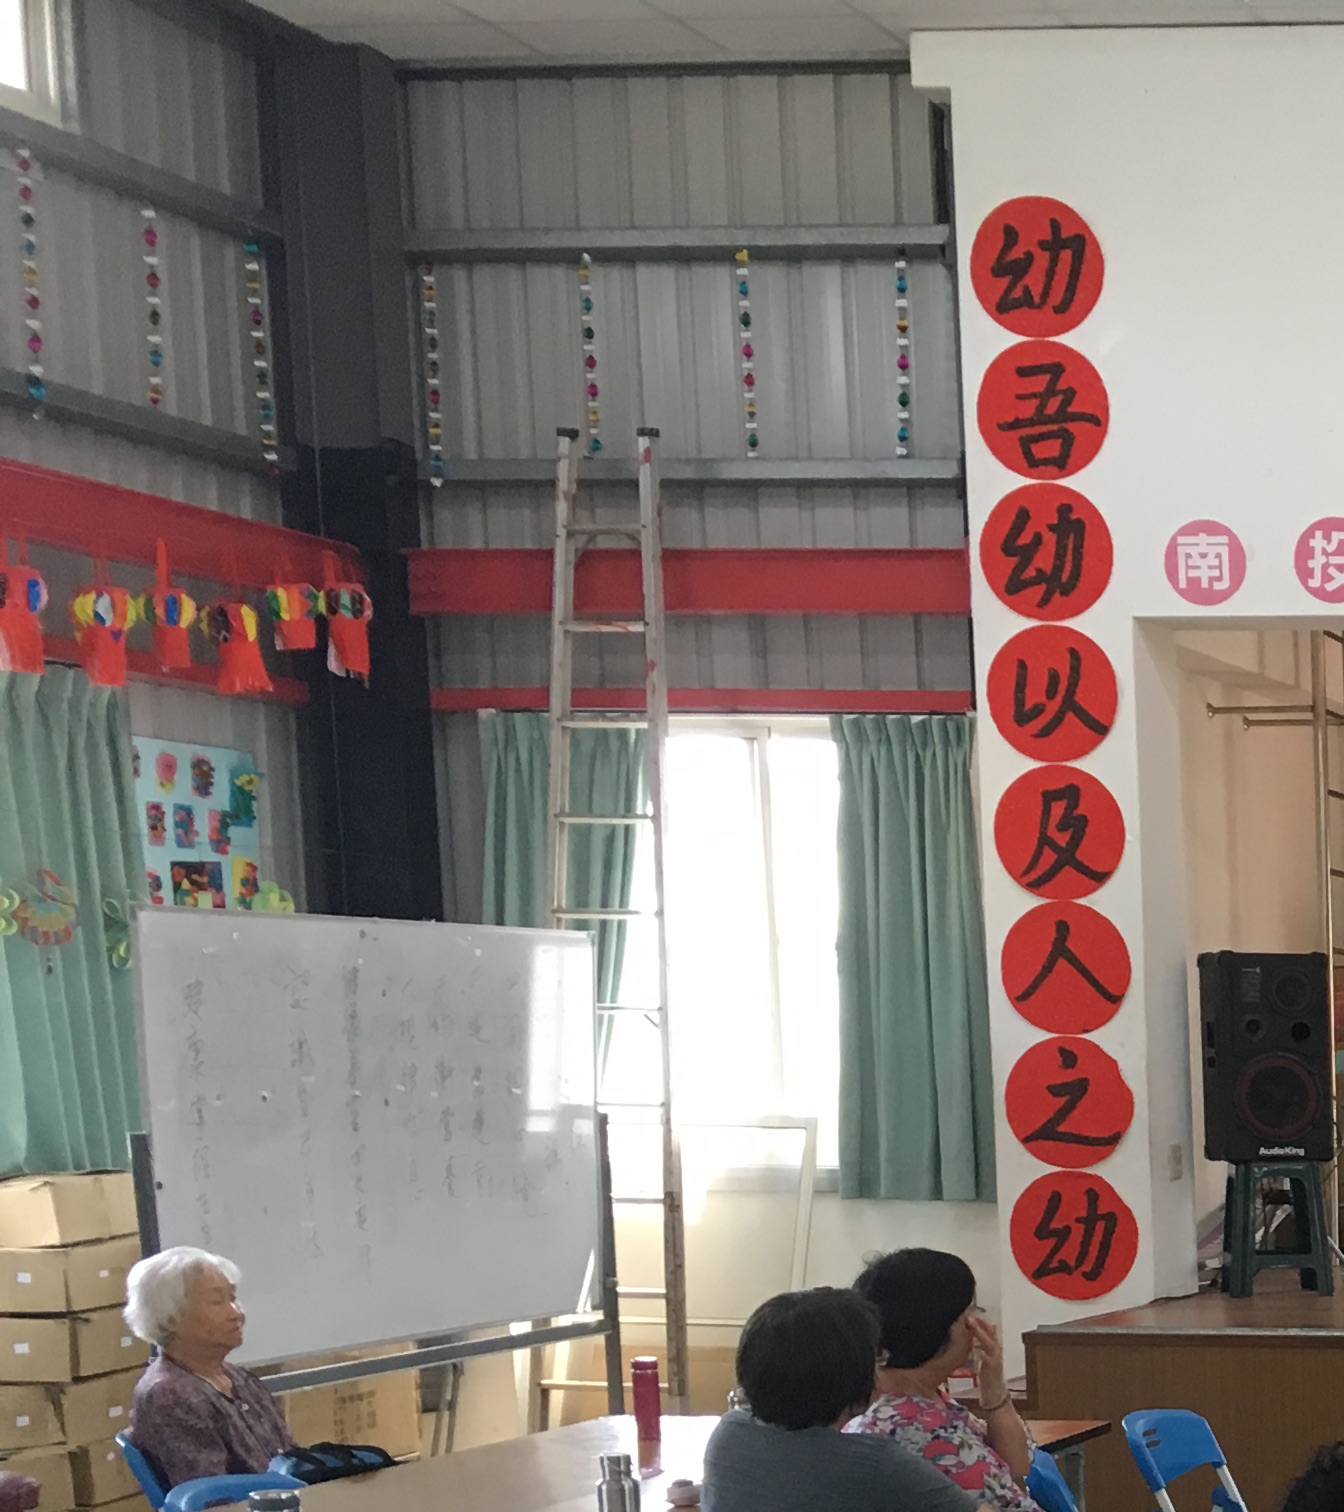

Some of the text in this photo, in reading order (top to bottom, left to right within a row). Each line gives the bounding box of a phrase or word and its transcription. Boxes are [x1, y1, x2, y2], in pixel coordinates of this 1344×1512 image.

[990, 218, 1125, 1282] 幼吾幼以及人之幼
